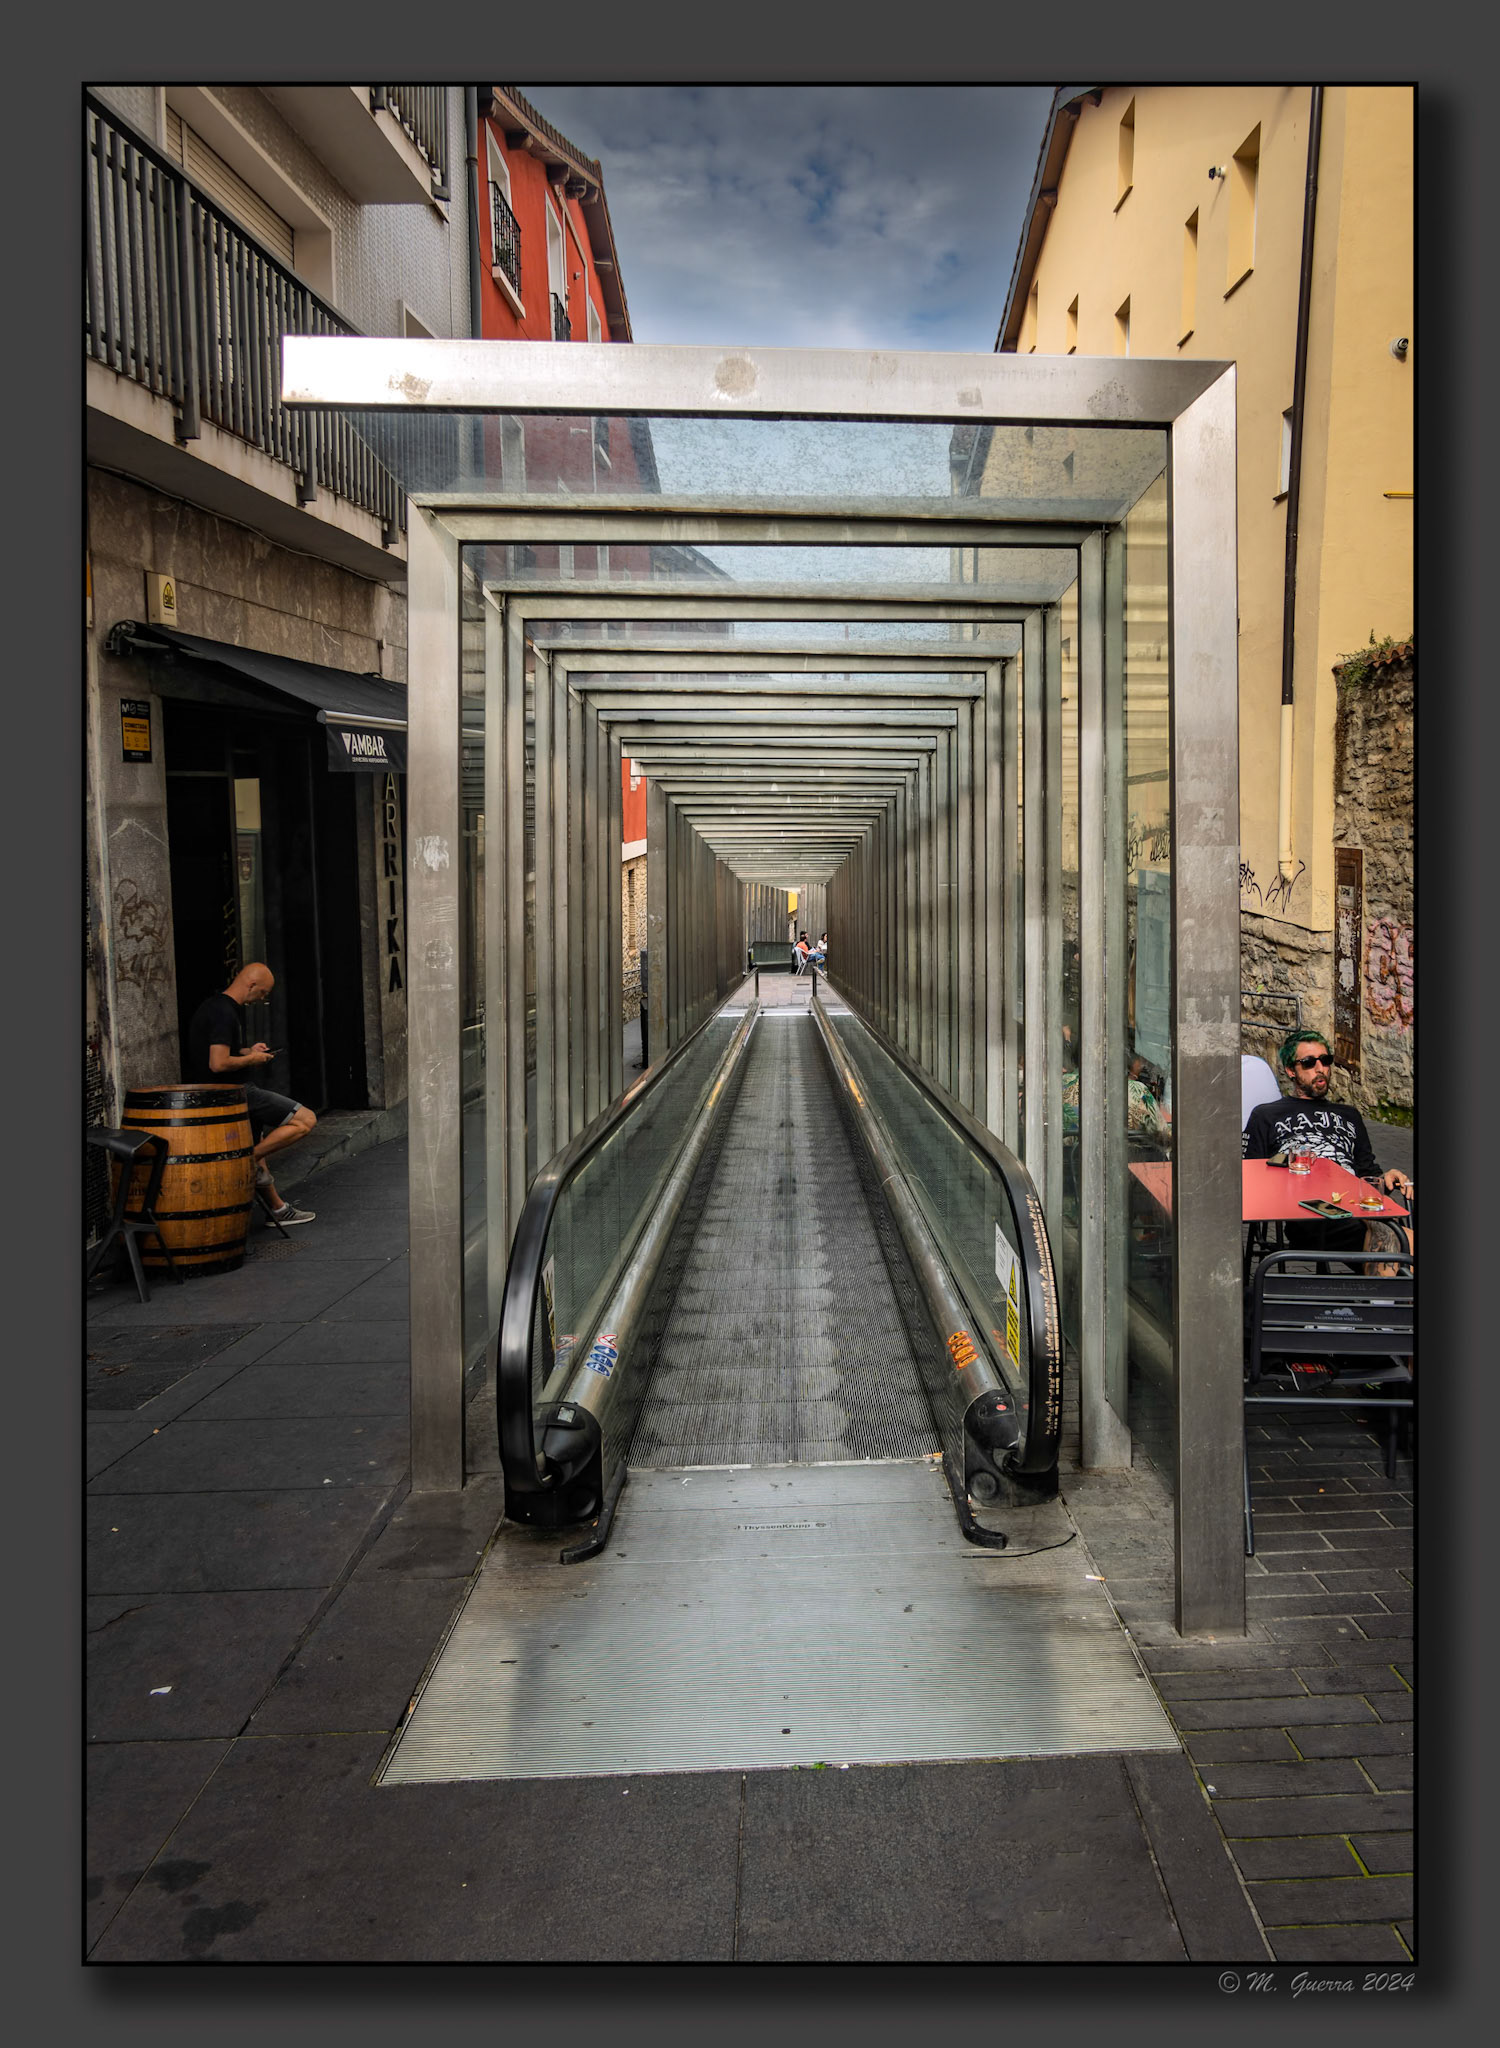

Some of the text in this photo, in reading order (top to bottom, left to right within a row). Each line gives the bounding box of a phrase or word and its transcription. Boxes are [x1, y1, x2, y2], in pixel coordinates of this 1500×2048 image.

[351, 733, 387, 757] AMBAR
[1275, 1111, 1357, 1139] NAILS
[743, 1523, 811, 1531] ThyssenKrupp
